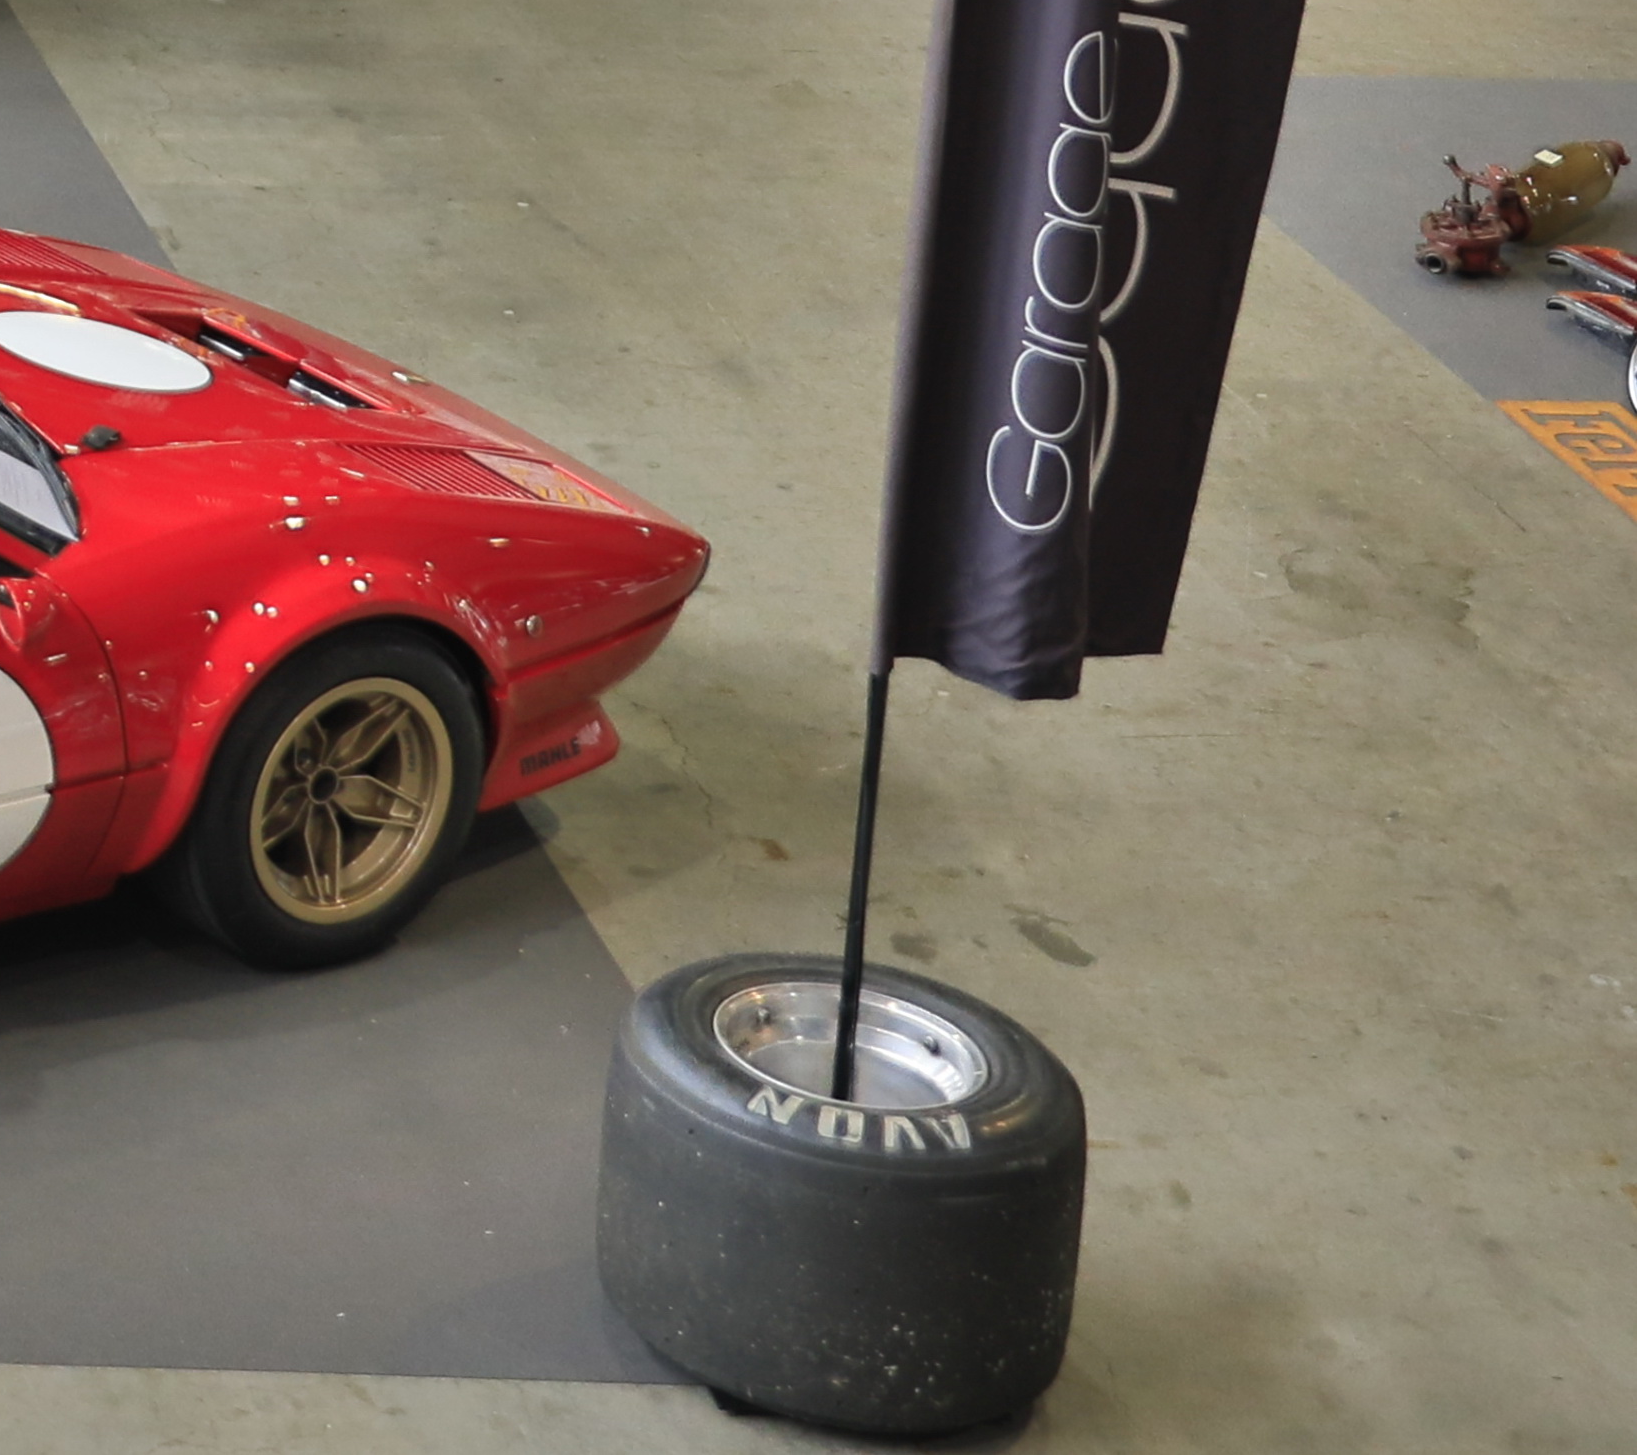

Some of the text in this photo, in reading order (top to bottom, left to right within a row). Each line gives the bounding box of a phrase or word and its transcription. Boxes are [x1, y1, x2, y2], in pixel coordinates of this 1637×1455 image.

[985, 29, 1116, 533] Garage
[520, 737, 582, 777] MAHLE
[746, 1085, 972, 1154] AVON
